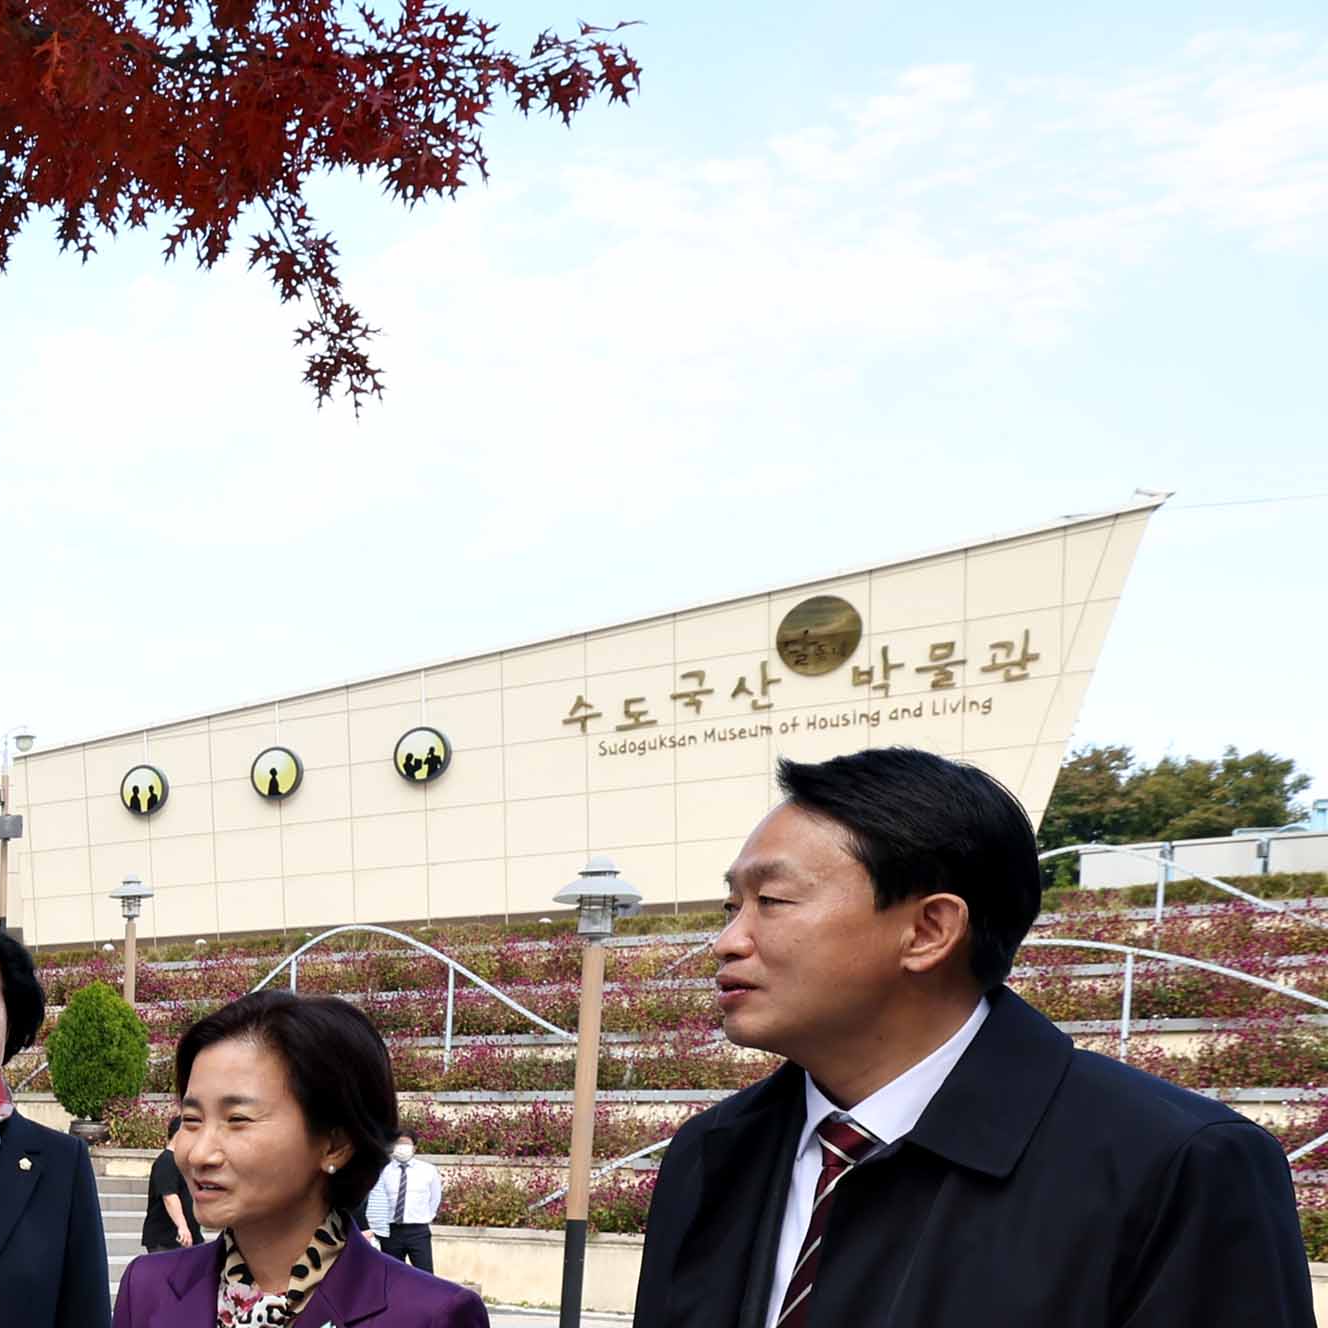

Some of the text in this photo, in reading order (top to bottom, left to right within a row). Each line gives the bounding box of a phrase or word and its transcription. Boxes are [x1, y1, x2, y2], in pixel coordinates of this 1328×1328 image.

[851, 628, 1041, 699] 박물관
[598, 696, 993, 757] Sudoguksan Museum of Housing and Living
